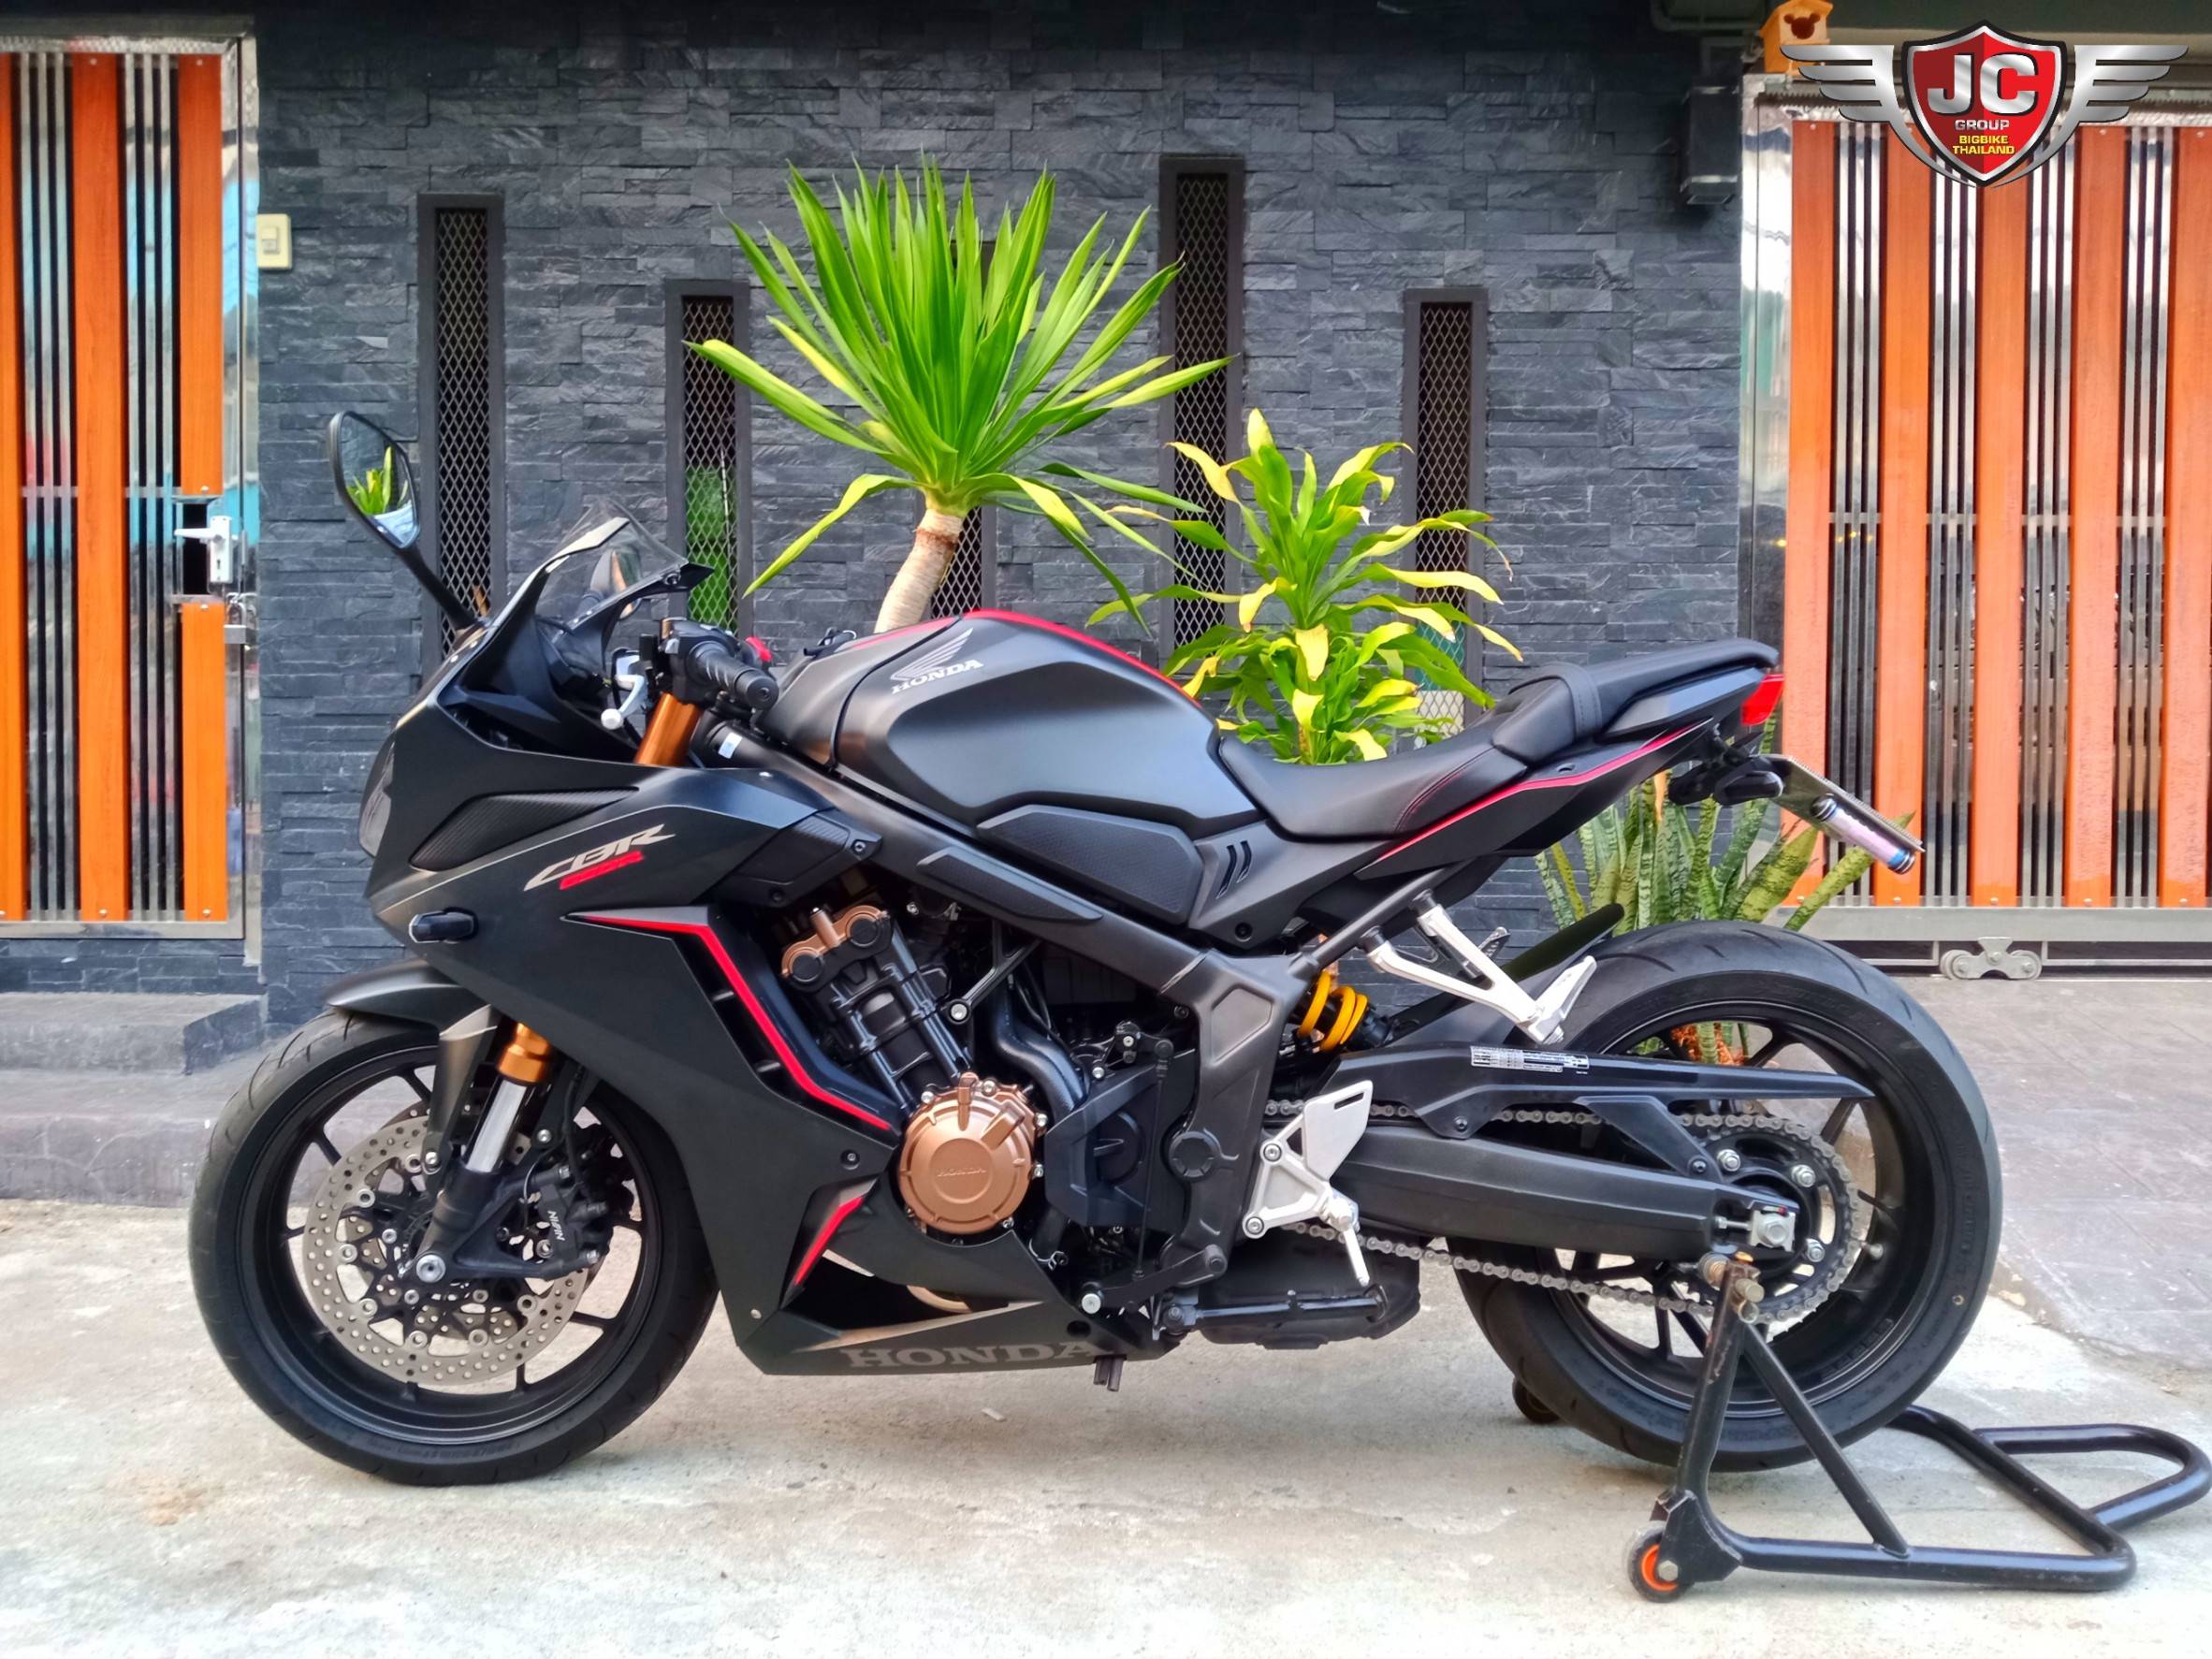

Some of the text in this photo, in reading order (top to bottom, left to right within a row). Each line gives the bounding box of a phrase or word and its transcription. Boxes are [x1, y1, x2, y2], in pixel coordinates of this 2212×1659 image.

[891, 659, 984, 694] HONDA
[524, 823, 676, 892] CBR
[843, 1341, 1113, 1368] HONDA
